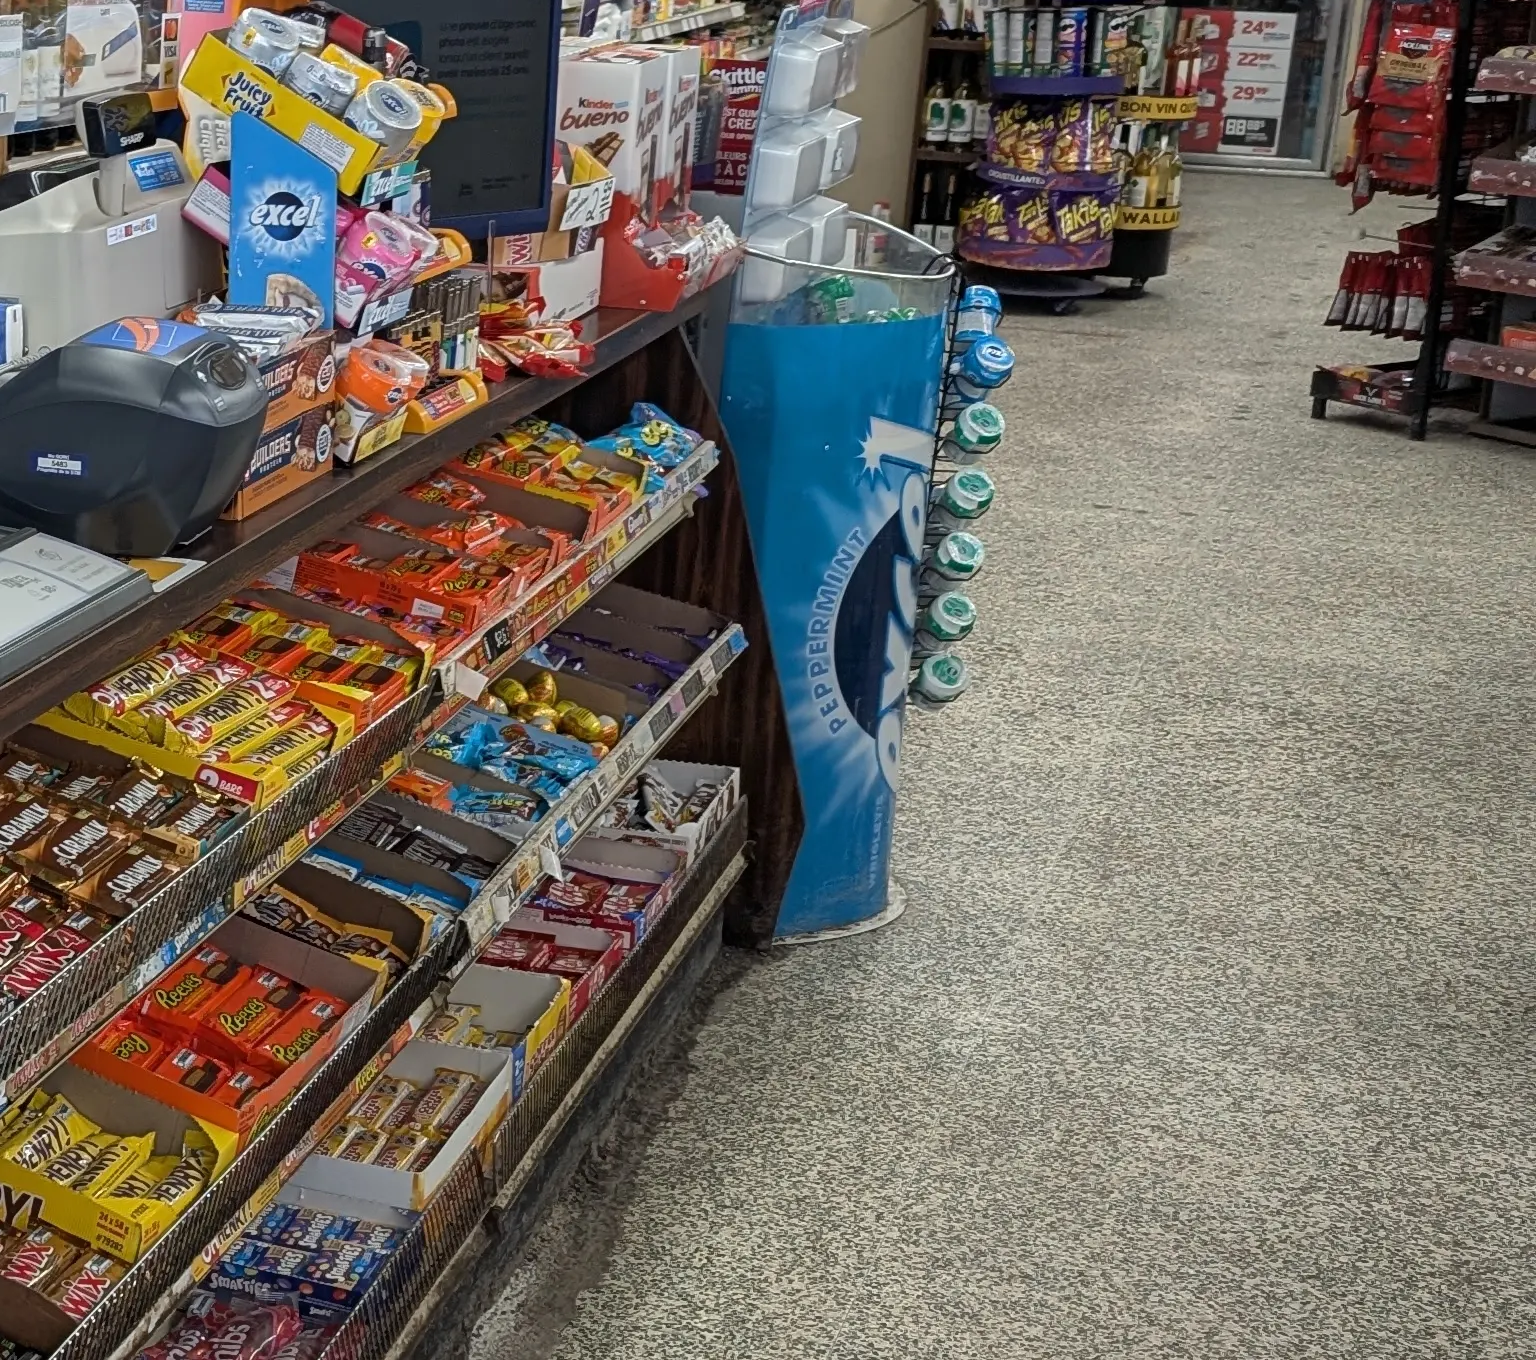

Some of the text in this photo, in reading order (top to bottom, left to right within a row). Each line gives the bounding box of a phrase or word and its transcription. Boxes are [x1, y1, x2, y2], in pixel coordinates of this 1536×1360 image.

[228, 71, 273, 109] Juicy
[710, 67, 766, 87] Skittle
[560, 108, 630, 131] bueno
[1120, 101, 1177, 114] BON VIN
[120, 132, 144, 146] SHARP
[248, 195, 321, 228] excel
[807, 526, 866, 738] PEPPERMINT
[198, 768, 243, 796] 2 BARS
[52, 819, 109, 860] CARAMILK
[155, 972, 204, 1010] Reese's
[219, 997, 266, 1036] Reese's
